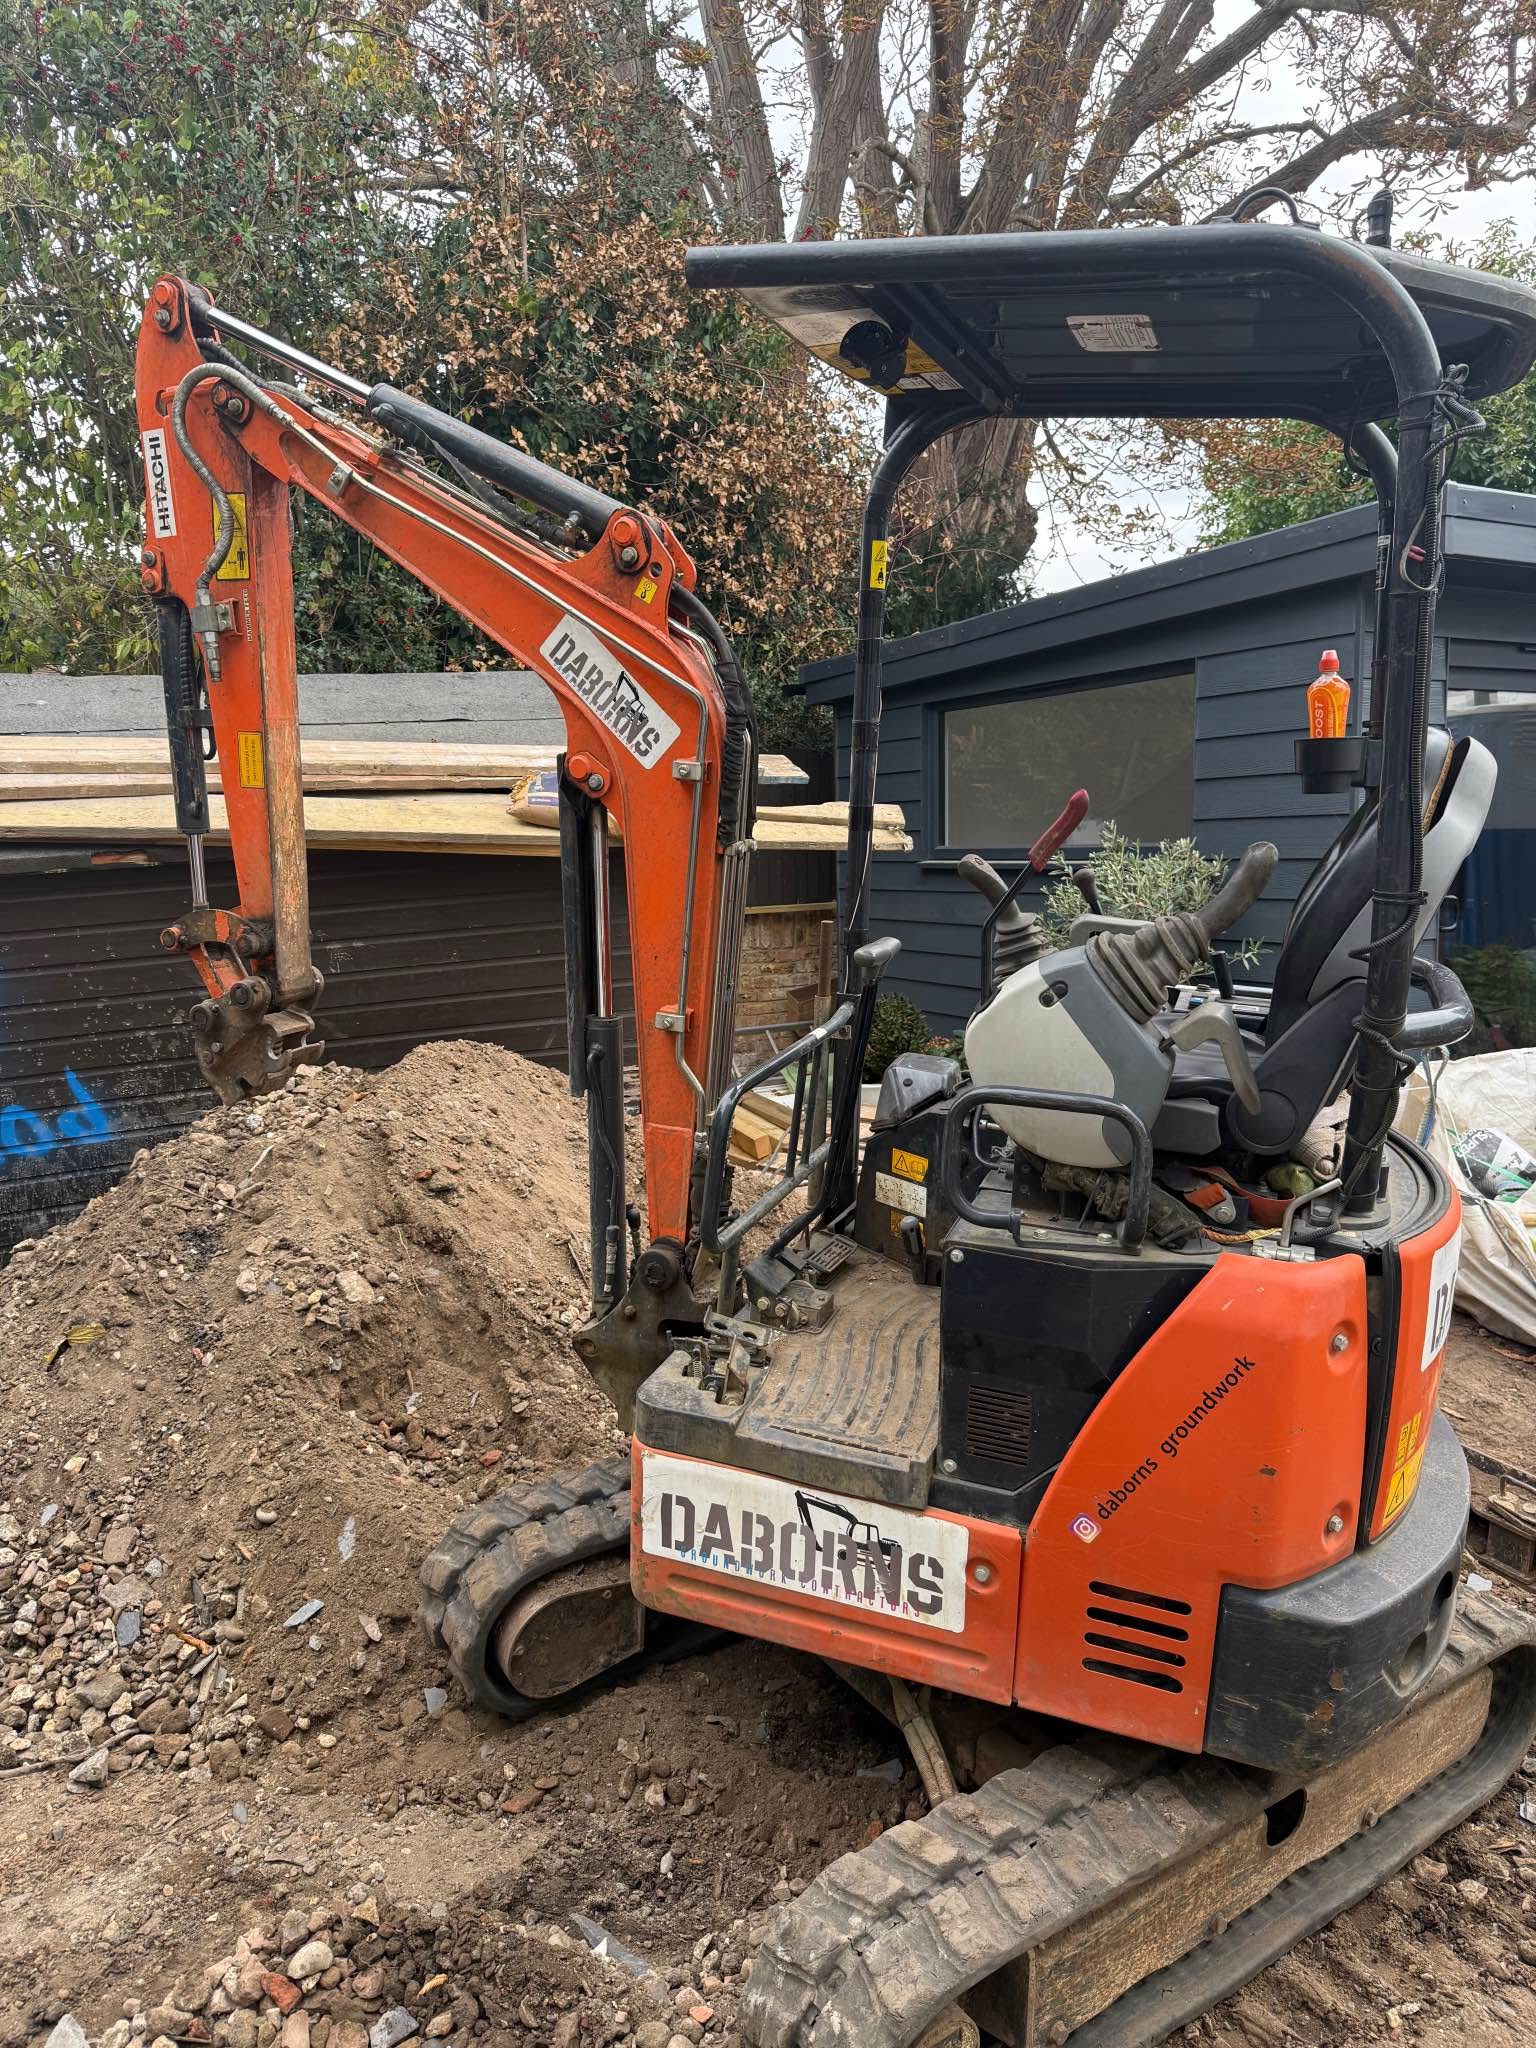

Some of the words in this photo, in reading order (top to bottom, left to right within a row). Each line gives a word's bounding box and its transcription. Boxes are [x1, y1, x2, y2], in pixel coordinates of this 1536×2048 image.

[149, 436, 170, 531] HITACHI
[549, 632, 660, 757] DABORNS
[1315, 700, 1324, 738] OOST
[1097, 1457, 1158, 1520] daborns
[1160, 1355, 1256, 1458] groundwork
[660, 1492, 944, 1616] DABORNS
[680, 1546, 787, 1584] GROUNDWORK
[800, 1578, 921, 1618] CONTRACTORS
